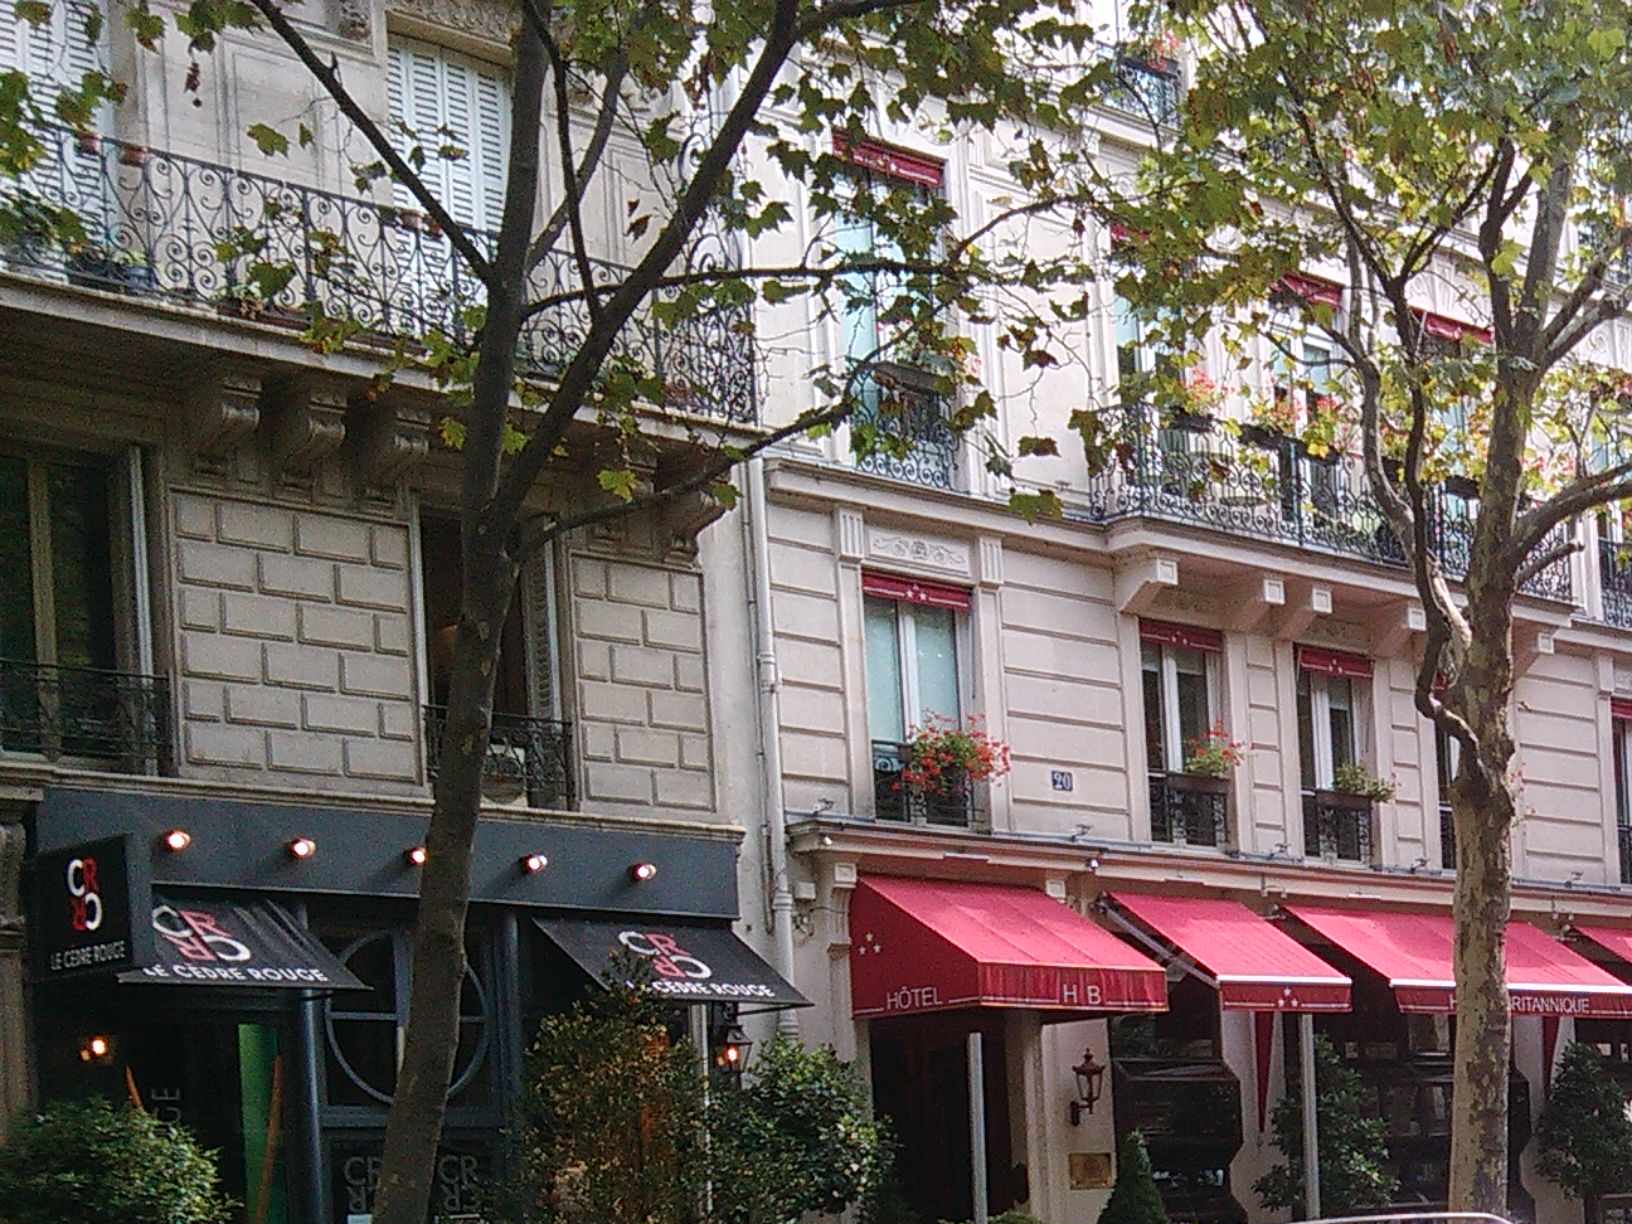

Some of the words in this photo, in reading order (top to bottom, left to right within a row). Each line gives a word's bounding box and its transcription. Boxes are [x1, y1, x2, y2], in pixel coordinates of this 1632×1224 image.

[93, 940, 125, 962] ROUGE
[246, 967, 329, 982] ROUGE
[709, 982, 776, 997] ROUGE
[1509, 995, 1590, 1014] RITANNIQUE
